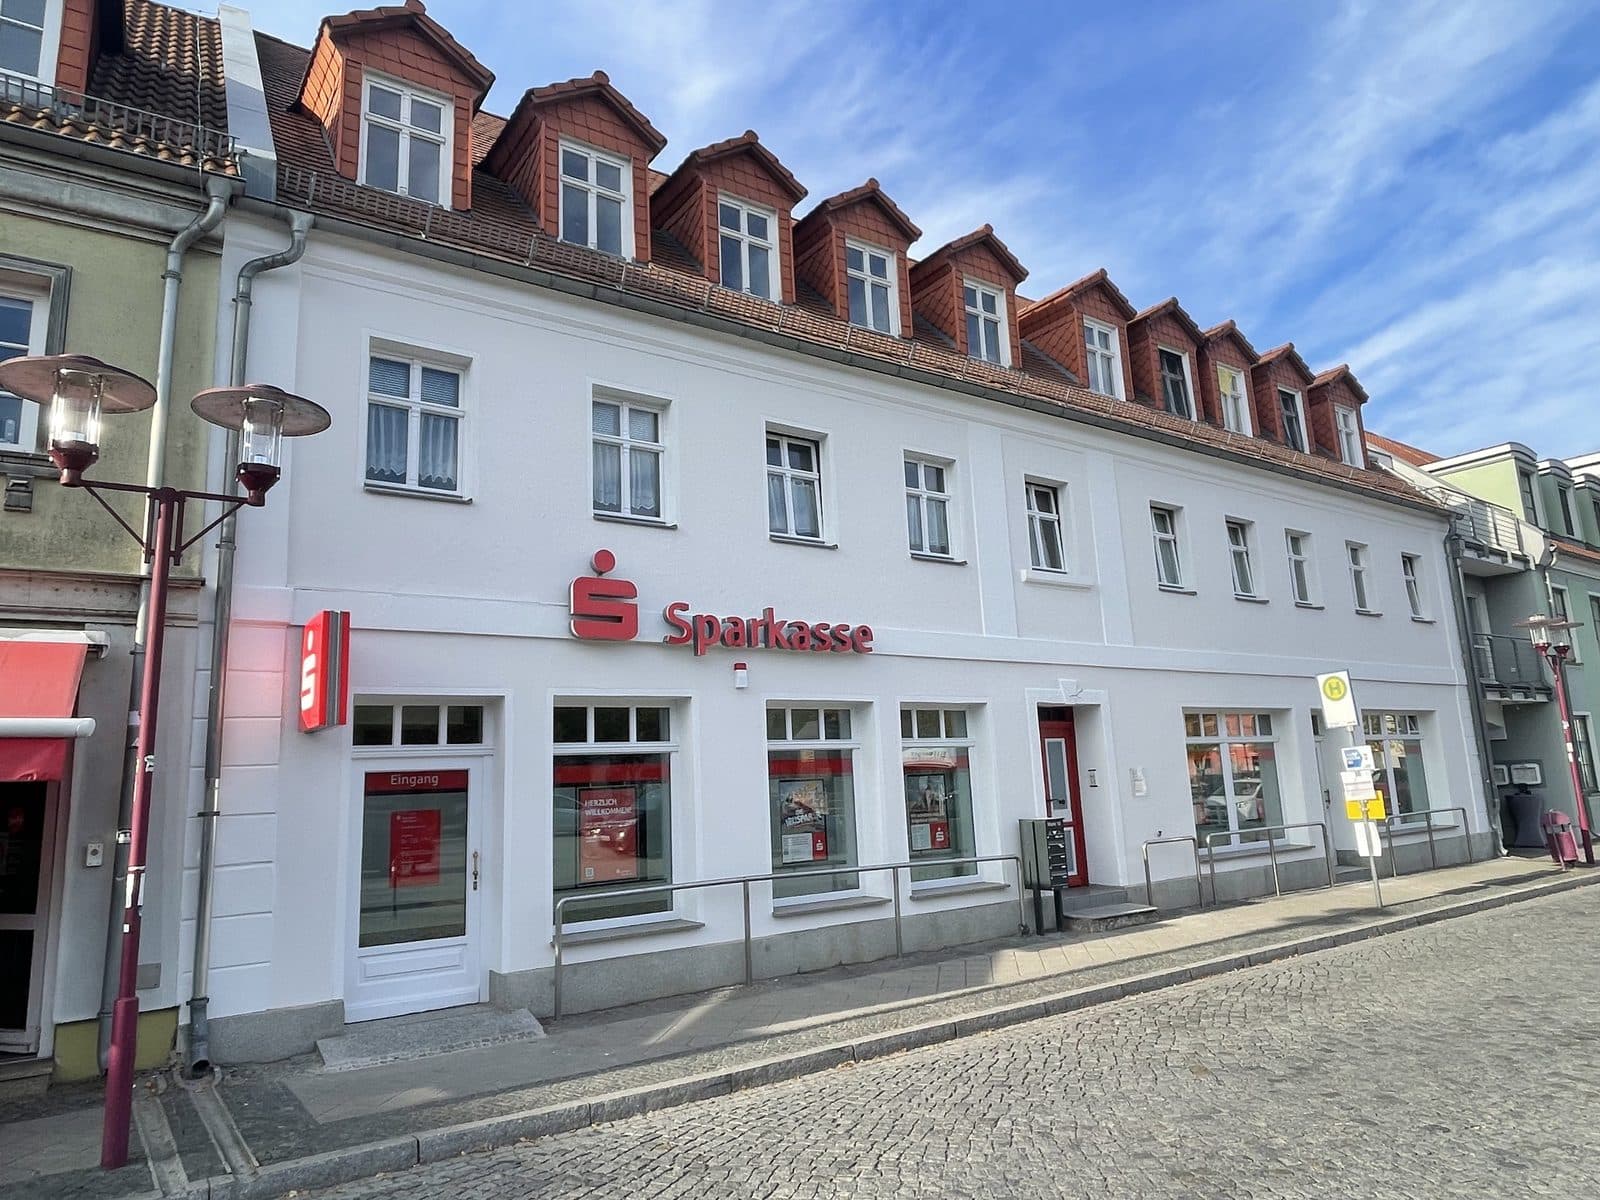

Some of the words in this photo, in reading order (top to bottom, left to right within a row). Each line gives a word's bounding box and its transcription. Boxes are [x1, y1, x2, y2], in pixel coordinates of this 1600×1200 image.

[663, 601, 874, 656] Sparkasse
[1328, 681, 1342, 697] H
[390, 774, 439, 787] Eingang
[584, 798, 618, 808] HERZLICH
